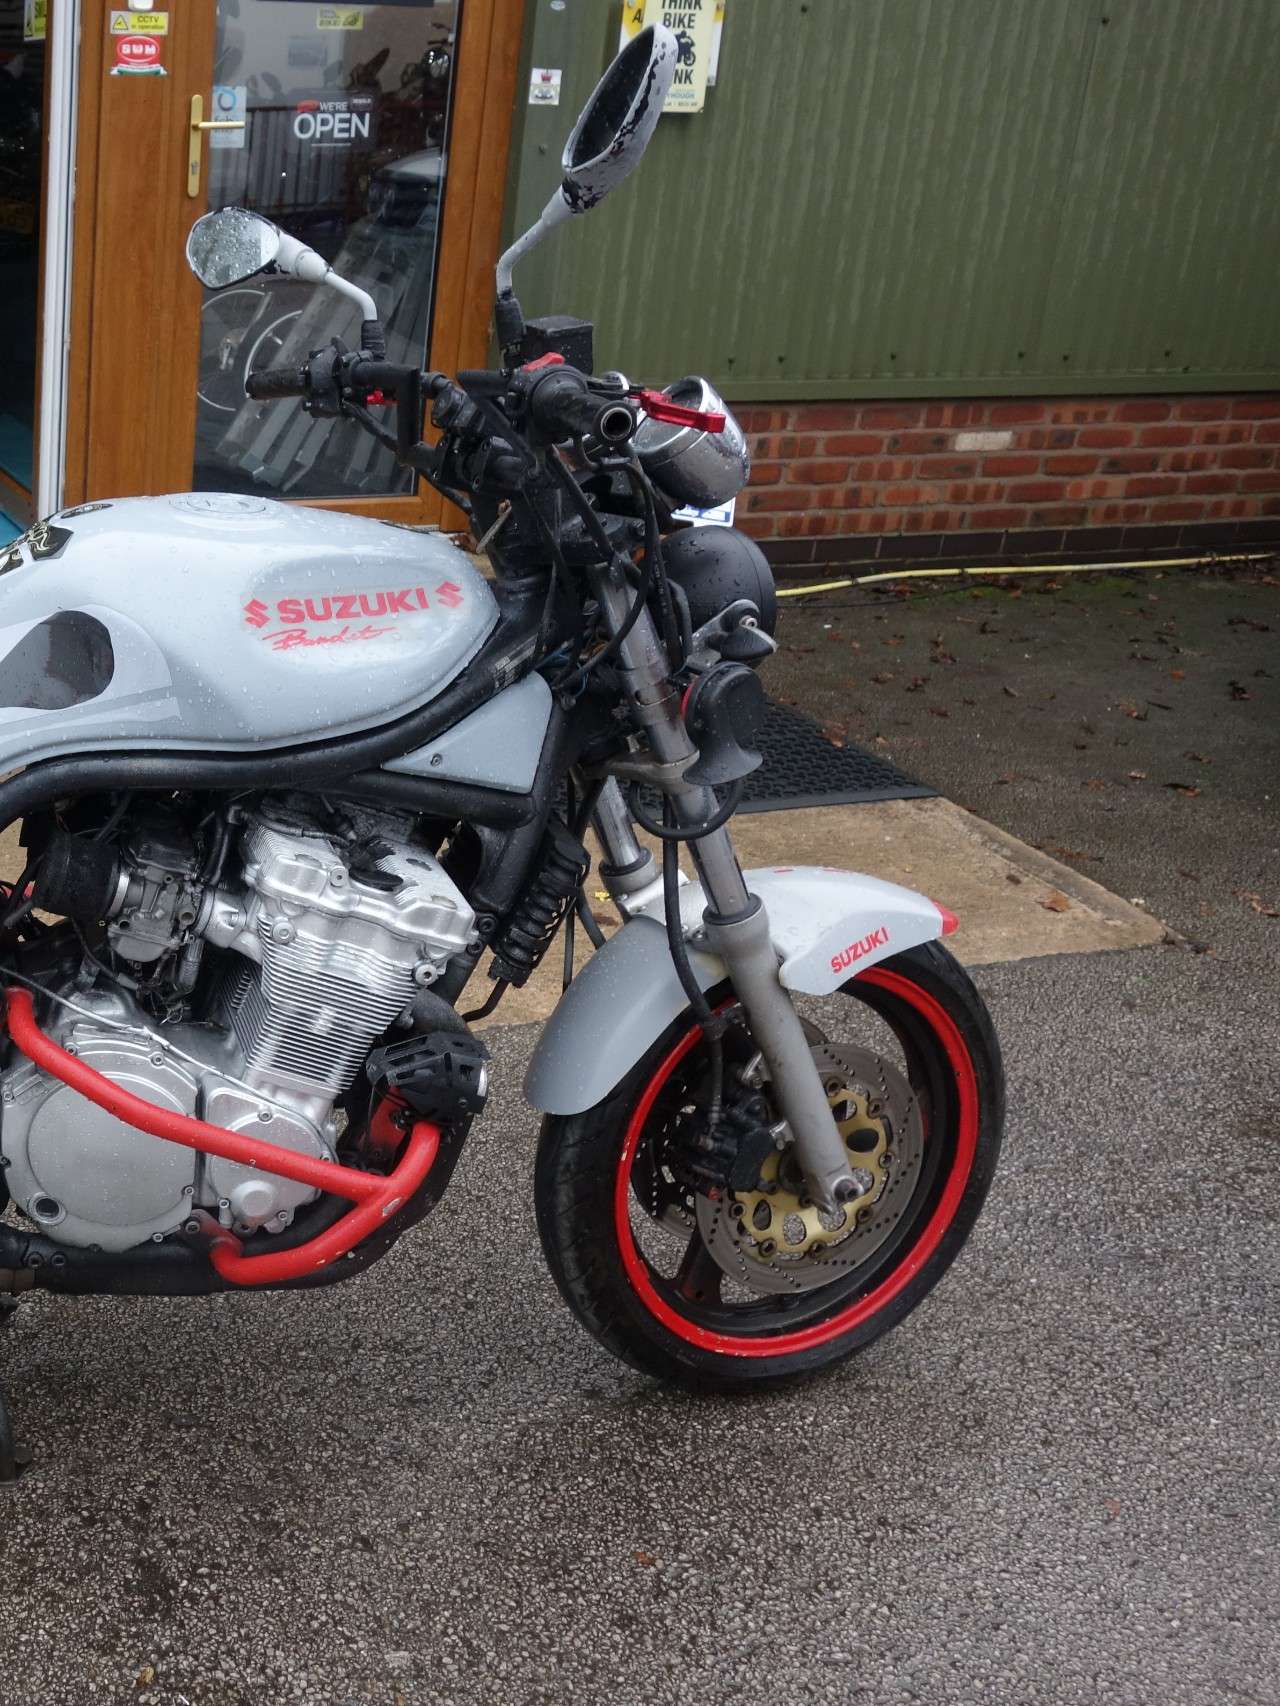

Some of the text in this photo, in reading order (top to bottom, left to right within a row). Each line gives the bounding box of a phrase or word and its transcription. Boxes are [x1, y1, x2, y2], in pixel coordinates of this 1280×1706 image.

[137, 16, 160, 24] CCTV
[662, 12, 696, 29] BIKE
[320, 101, 348, 112] WE'RE
[293, 112, 370, 139] OPEN
[276, 586, 430, 625] SUZUKI
[830, 926, 891, 975] SUZUKI
